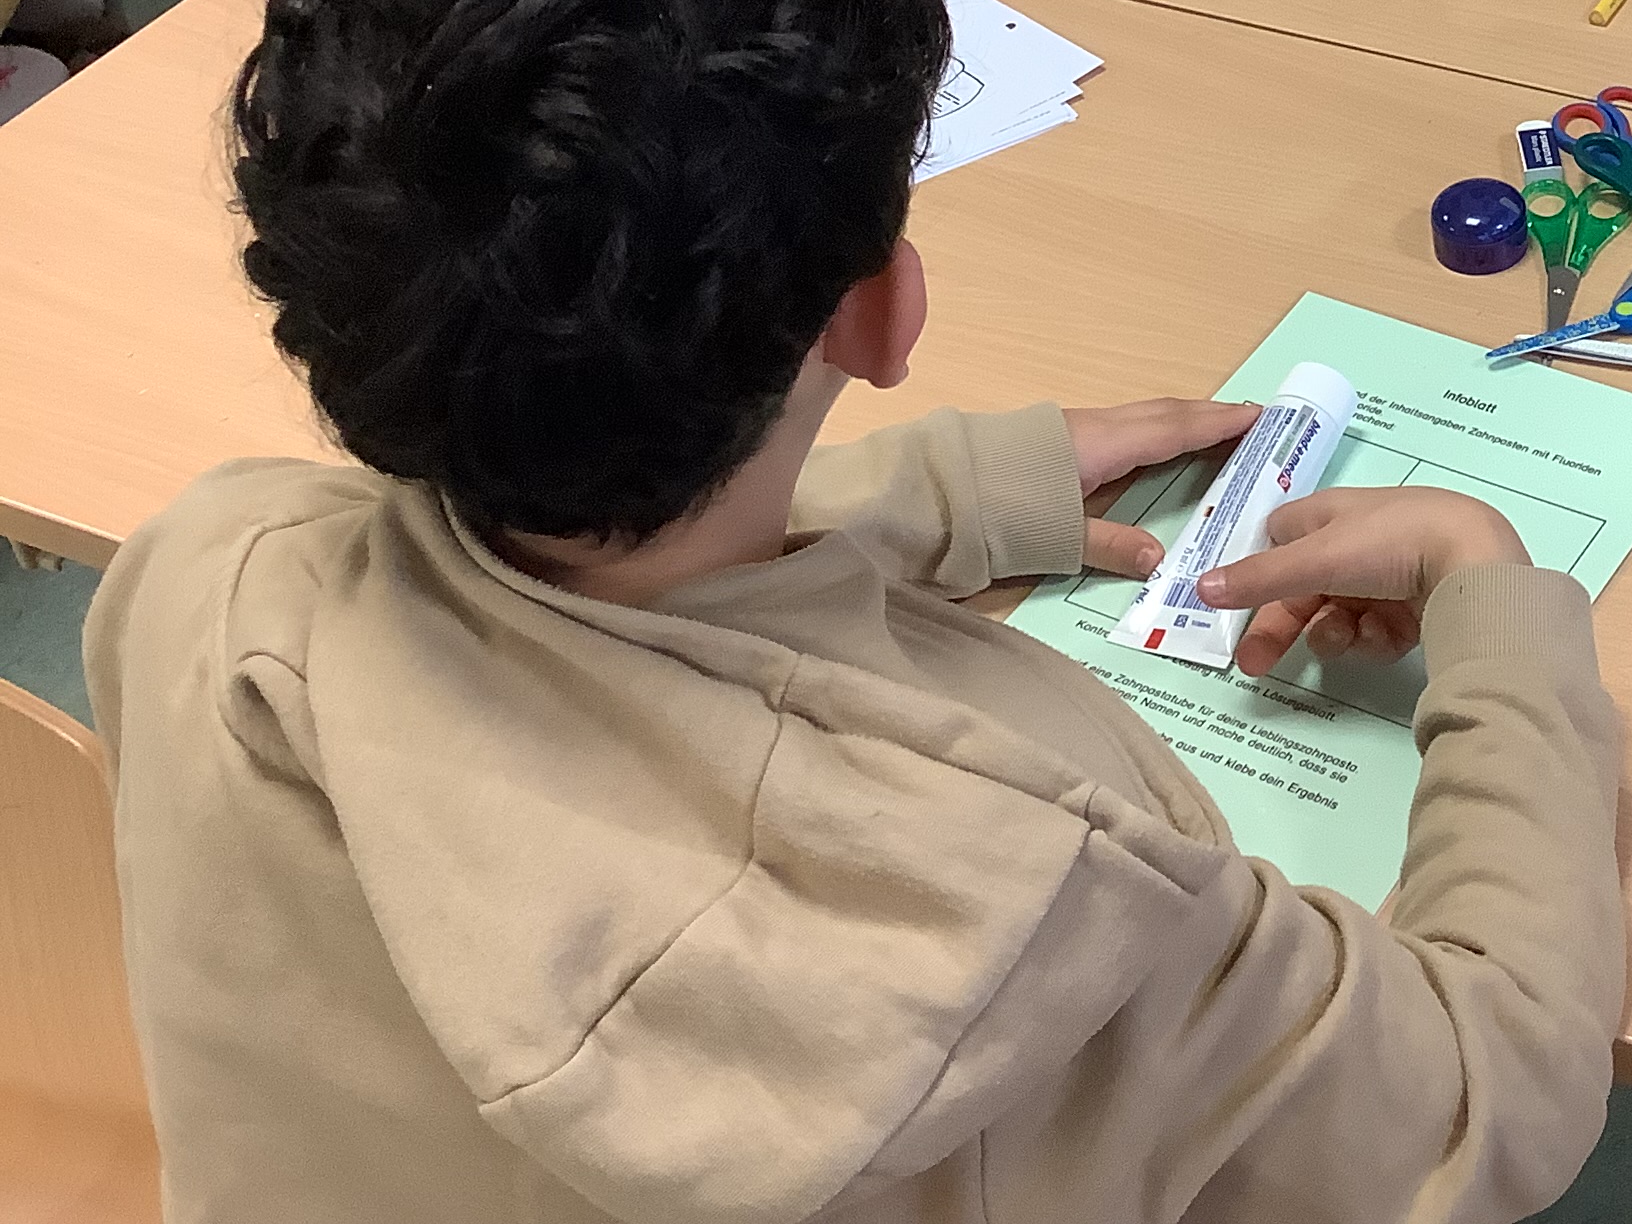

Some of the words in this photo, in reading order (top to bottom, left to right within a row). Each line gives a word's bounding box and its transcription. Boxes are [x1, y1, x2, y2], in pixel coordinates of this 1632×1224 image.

[1356, 402, 1384, 416] oride.
[1369, 395, 1387, 406] der
[1389, 401, 1466, 433] Inhaltsangaben
[1468, 427, 1529, 453] Zahnpasten
[1532, 447, 1550, 460] mit
[1552, 454, 1602, 476] Fluoriden
[1443, 389, 1498, 414] Infoblatt
[1089, 664, 1113, 679] eine
[1114, 674, 1195, 710] Zahnpastatube
[1198, 703, 1215, 718] für
[1217, 711, 1248, 730] deine
[1249, 724, 1359, 774] Lieblingszahnpasta.
[1214, 669, 1234, 684] mit
[1236, 678, 1260, 694] dem
[1262, 687, 1336, 721] Lösungsblatt.
[1140, 697, 1181, 719] Namen
[1183, 714, 1205, 728] und
[1207, 723, 1245, 743] mache
[1247, 739, 1294, 764] deutlich,
[1299, 759, 1327, 775] dass
[1329, 771, 1348, 784] sie
[1175, 741, 1197, 755] aus
[1200, 748, 1223, 764] und
[1224, 758, 1256, 776] klebe
[1259, 773, 1285, 789] dein
[1287, 784, 1339, 811] Ergebnis
